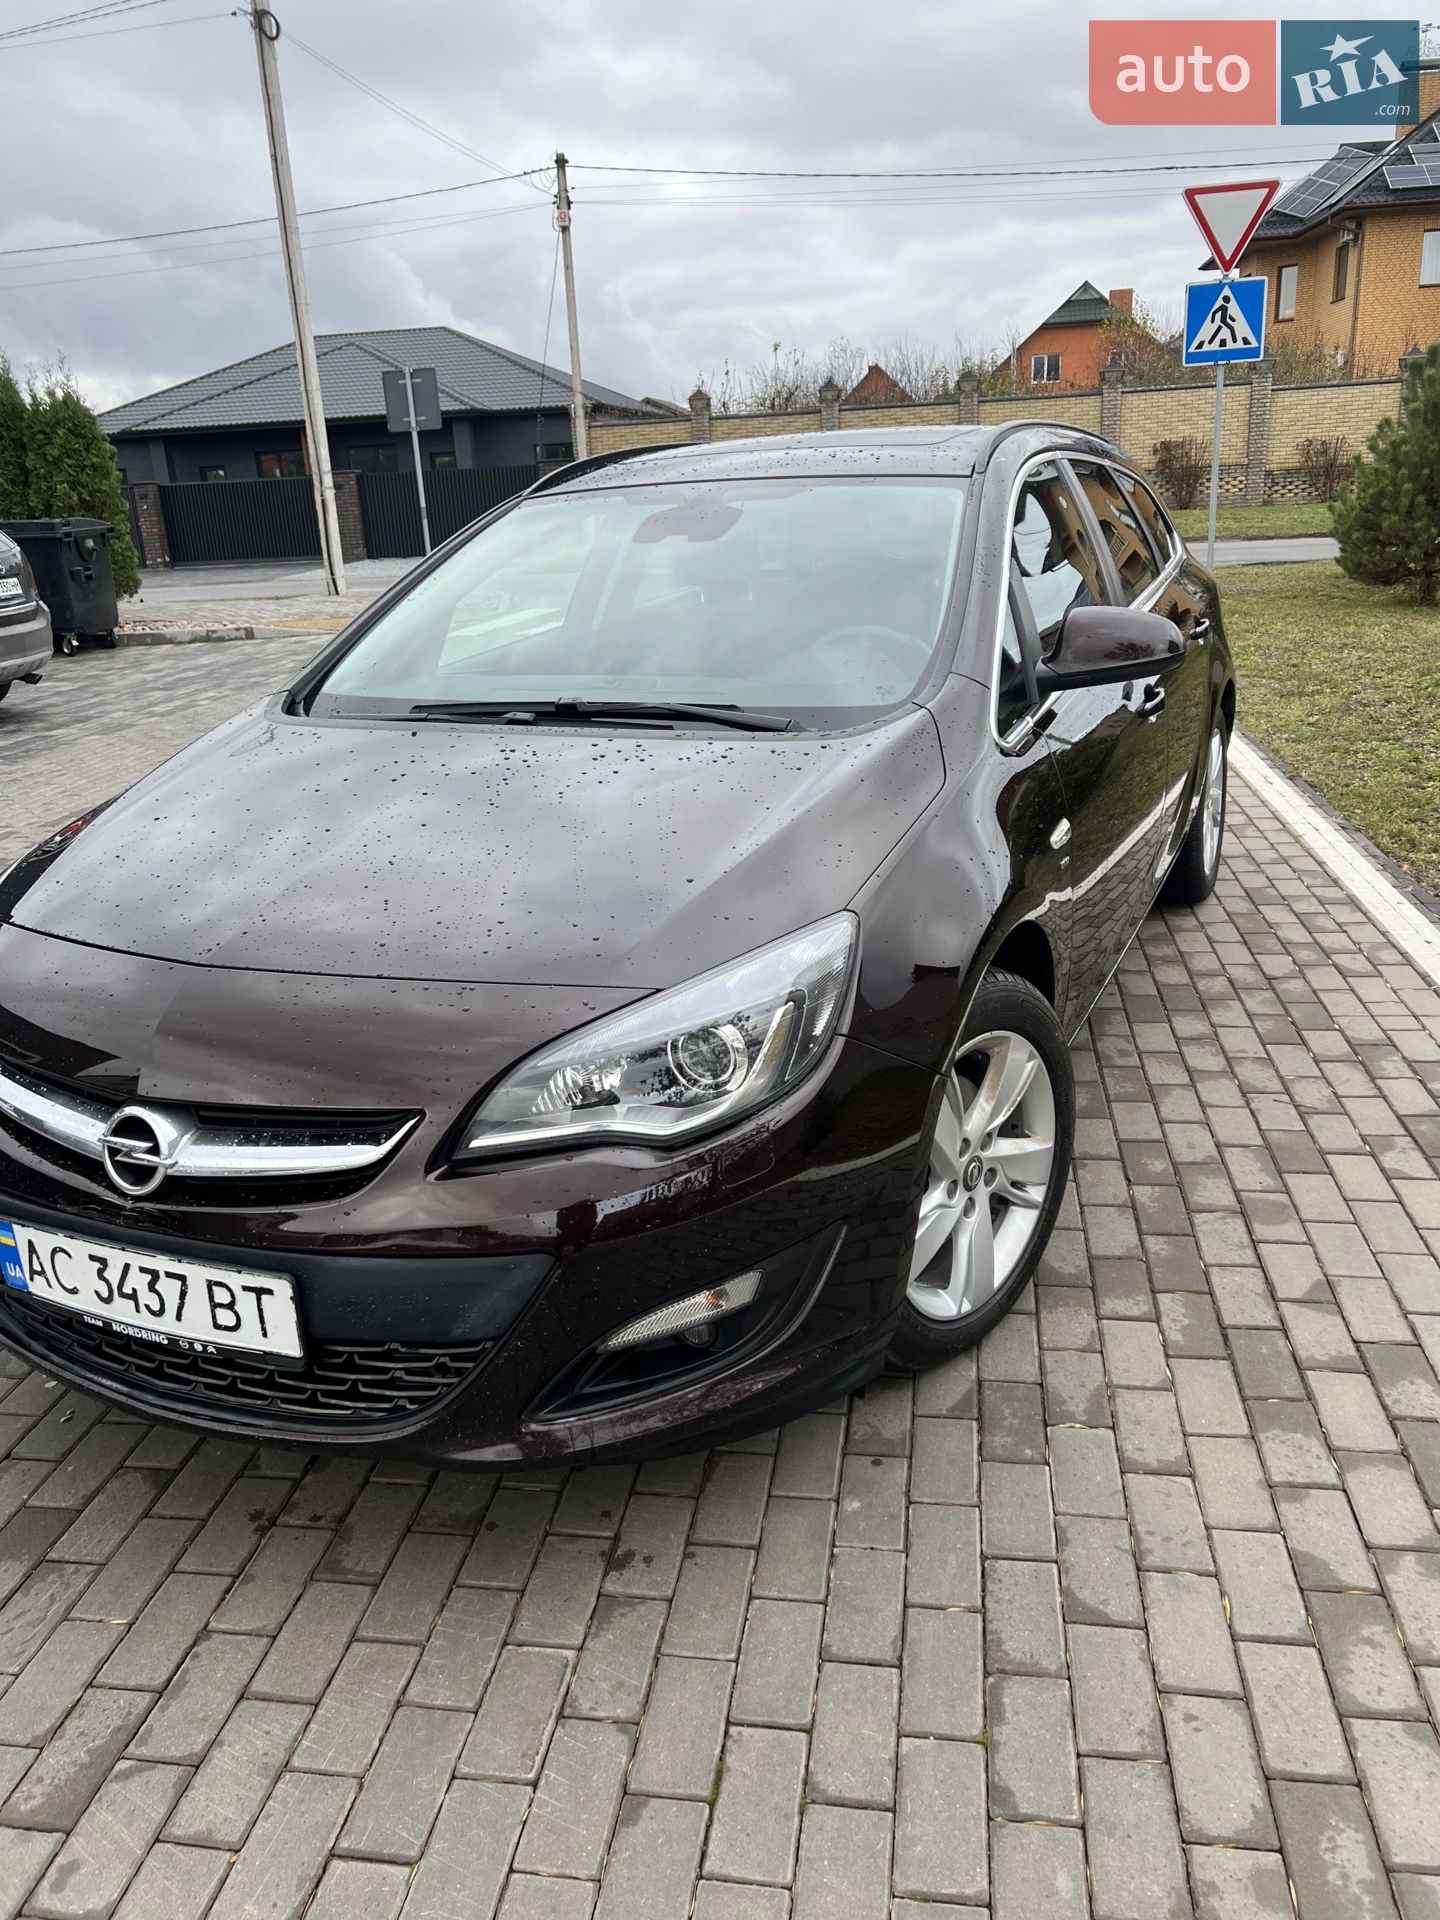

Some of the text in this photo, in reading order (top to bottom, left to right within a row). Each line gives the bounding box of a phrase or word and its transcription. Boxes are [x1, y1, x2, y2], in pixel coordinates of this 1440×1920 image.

[6, 1265, 24, 1280] UA
[27, 1238, 274, 1339] AC 3437 BT
[83, 1315, 169, 1345] TEAM NORDRING
